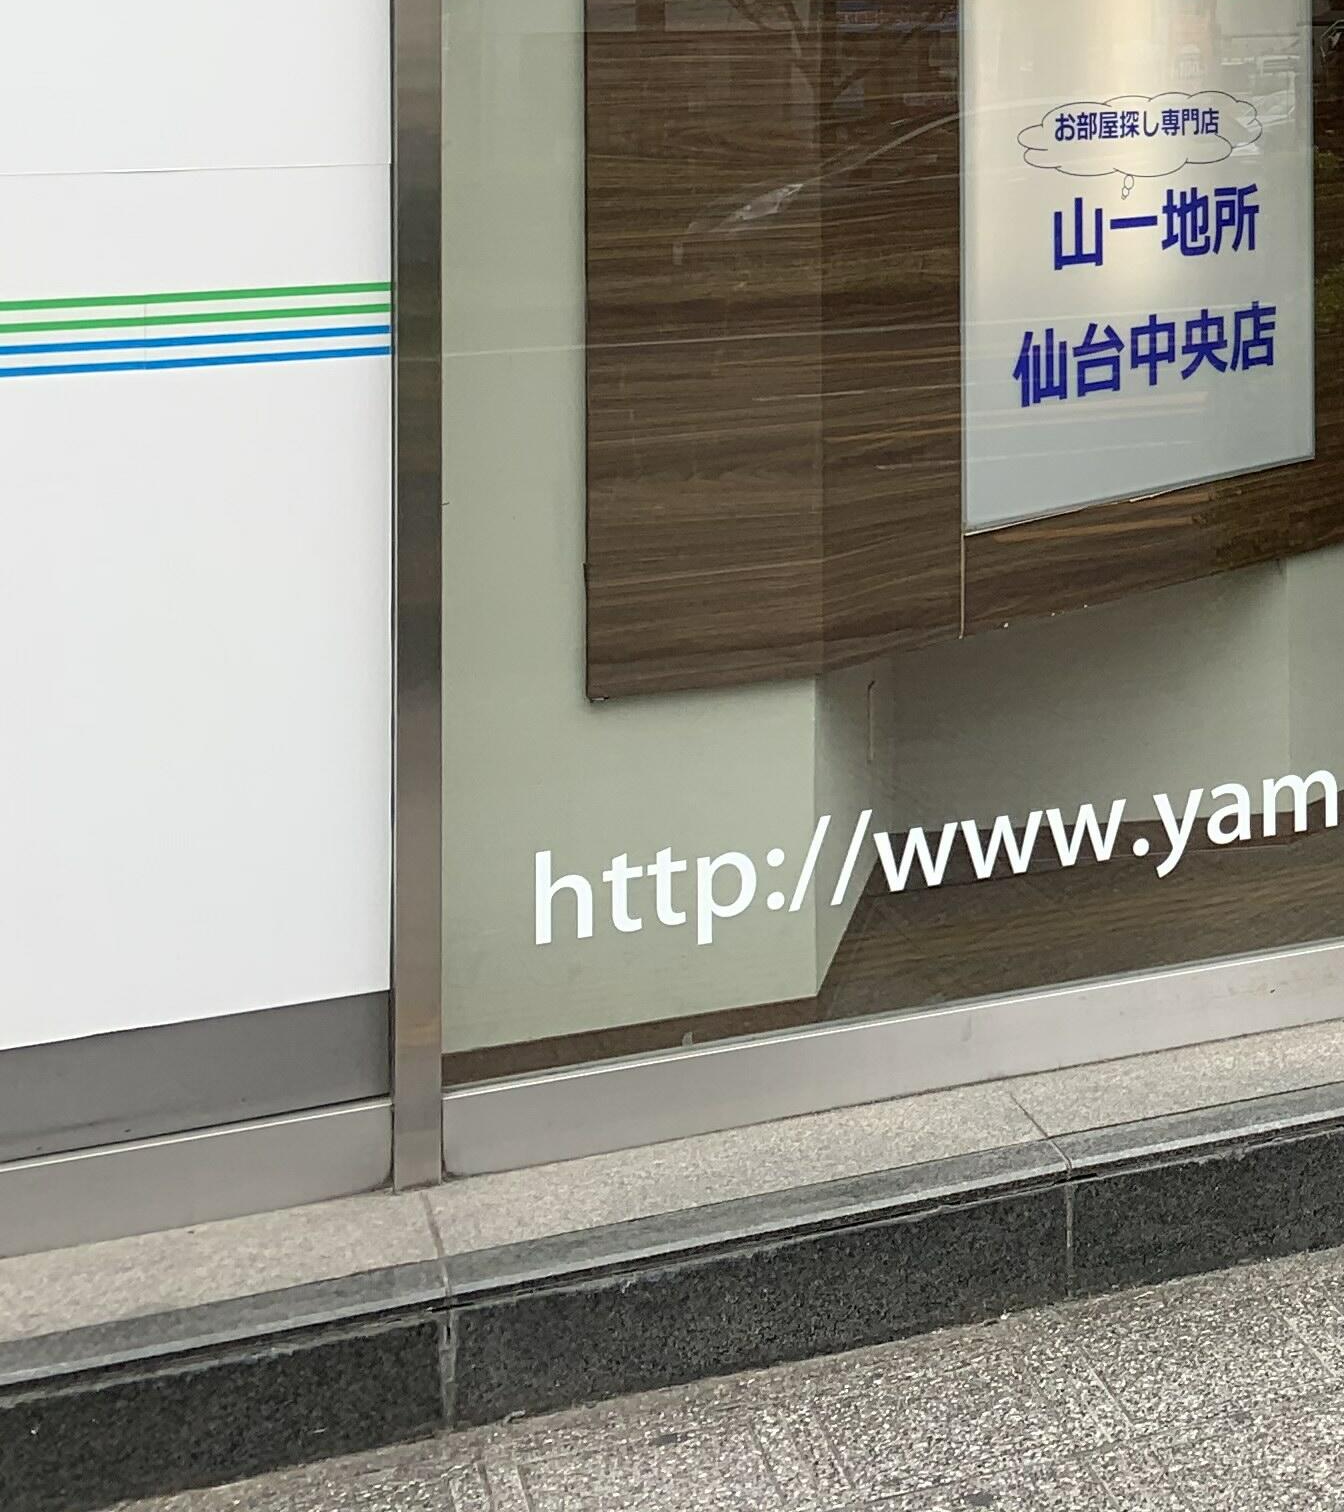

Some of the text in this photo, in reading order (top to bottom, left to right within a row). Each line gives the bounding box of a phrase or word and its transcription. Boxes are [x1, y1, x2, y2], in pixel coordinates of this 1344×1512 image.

[1054, 108, 1220, 141] お部屋探し専門店
[1052, 183, 1259, 271] 山一地所
[1013, 303, 1278, 409] 仙台中央店
